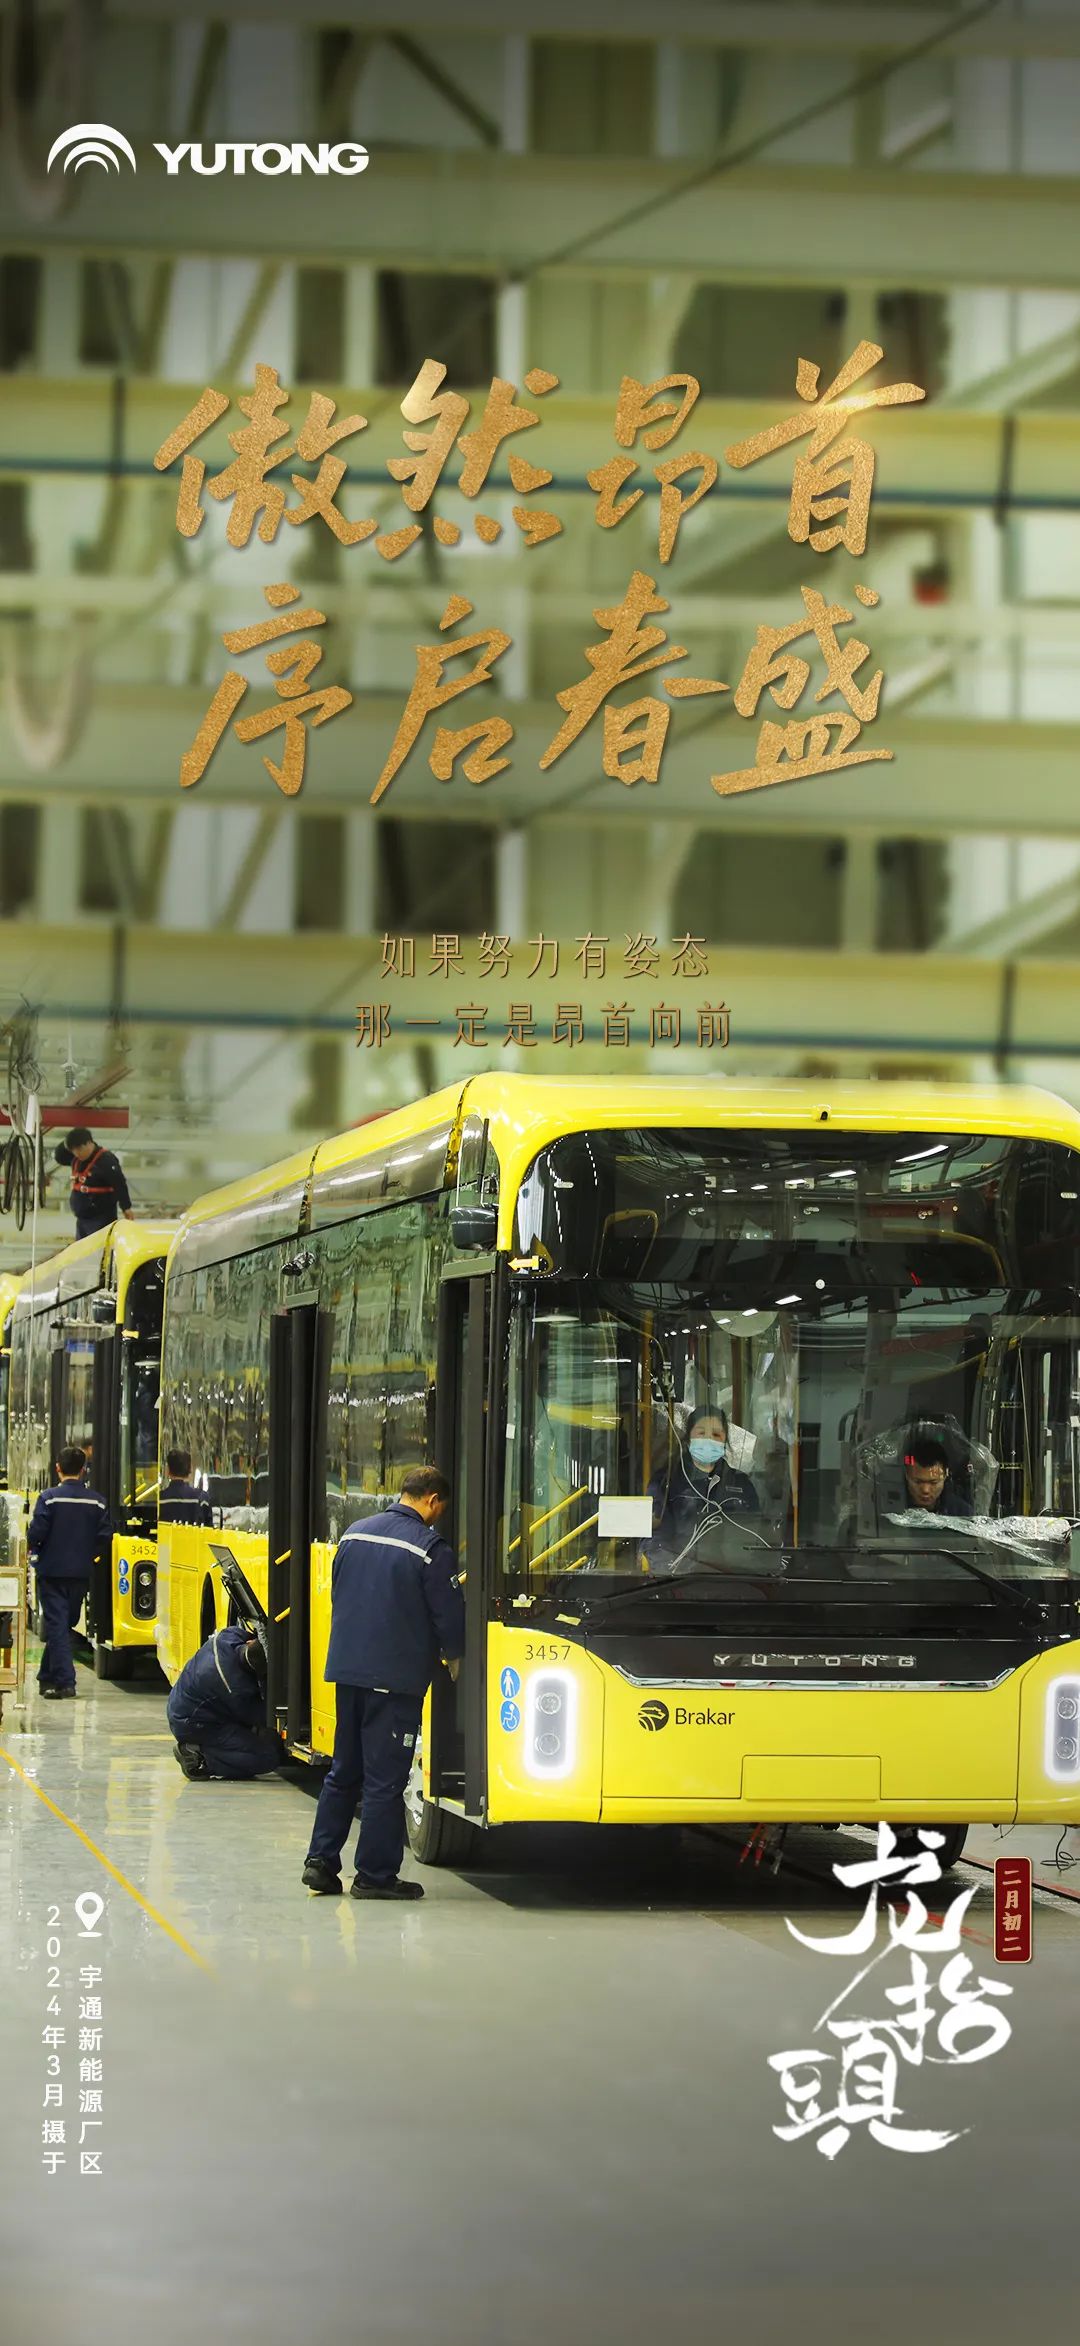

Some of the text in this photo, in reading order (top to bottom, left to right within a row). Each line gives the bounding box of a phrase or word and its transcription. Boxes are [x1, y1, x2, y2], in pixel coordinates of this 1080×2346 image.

[130, 1545, 158, 1556] 3452
[524, 1644, 572, 1661] 3457
[674, 1707, 736, 1726] Brakar
